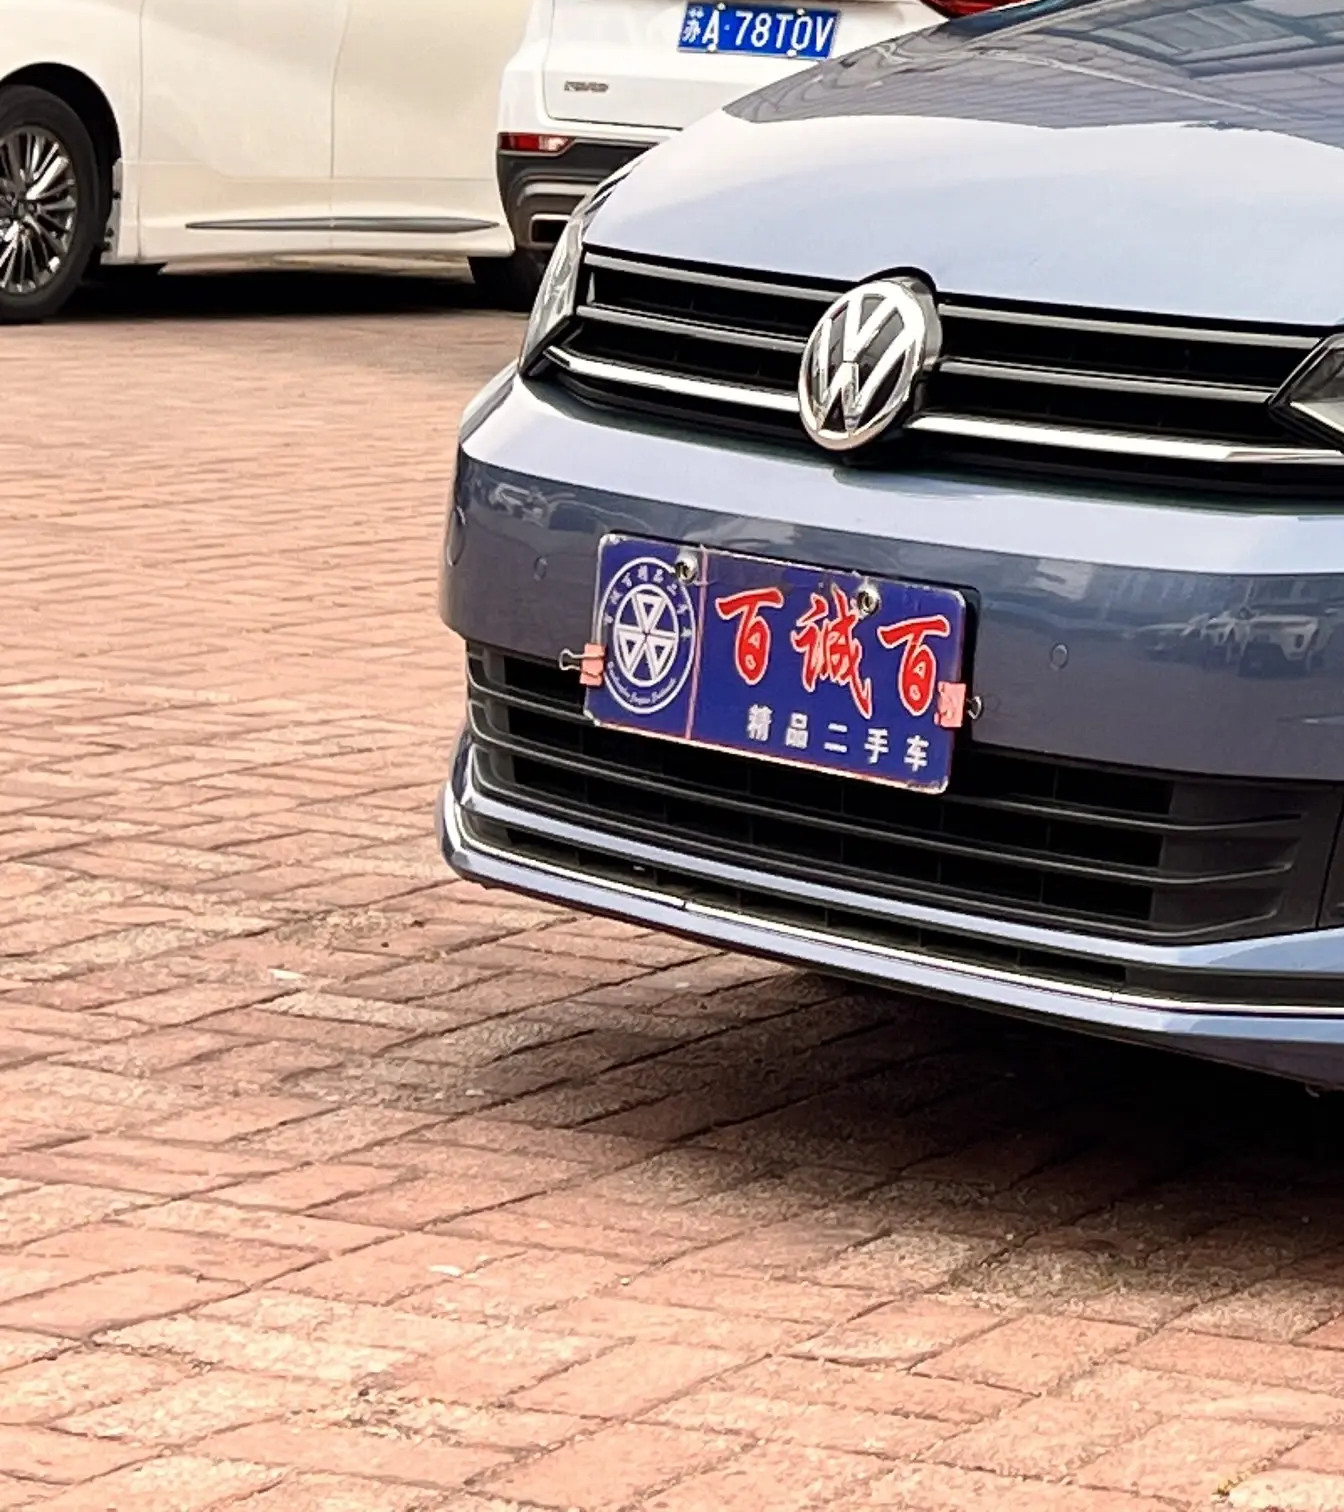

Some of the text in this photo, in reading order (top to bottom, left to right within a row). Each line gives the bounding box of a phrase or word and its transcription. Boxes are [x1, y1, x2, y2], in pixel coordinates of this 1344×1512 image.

[744, 701, 931, 772] 精品二手车
